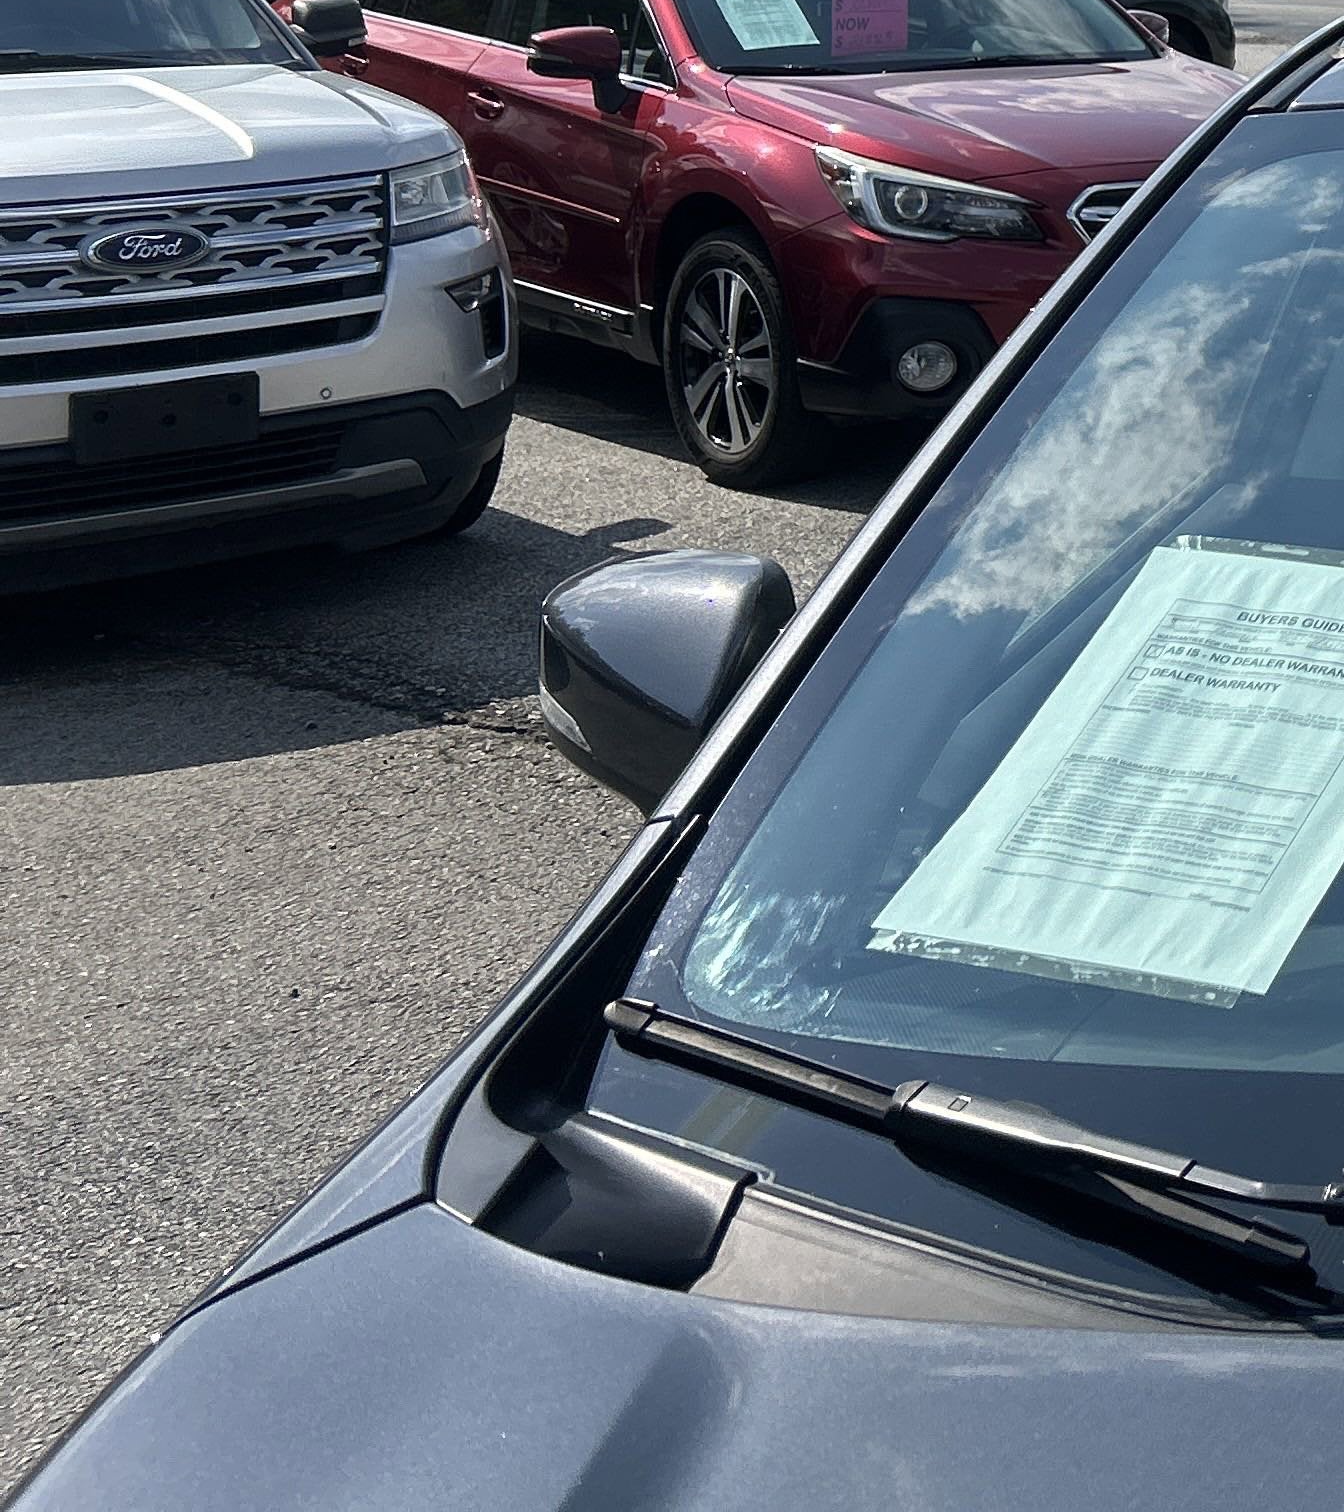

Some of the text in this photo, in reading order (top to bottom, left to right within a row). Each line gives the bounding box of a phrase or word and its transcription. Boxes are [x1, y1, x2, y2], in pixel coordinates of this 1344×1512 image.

[835, 17, 870, 31] NOW
[119, 234, 182, 260] Ford
[1237, 611, 1298, 627] BUYERS
[1164, 646, 1184, 656] AS
[1185, 647, 1201, 659] IS
[1209, 652, 1231, 665] NO
[1232, 657, 1285, 670] DEALER
[1150, 667, 1205, 685] DEALER
[1206, 676, 1282, 693] WARRANTY
